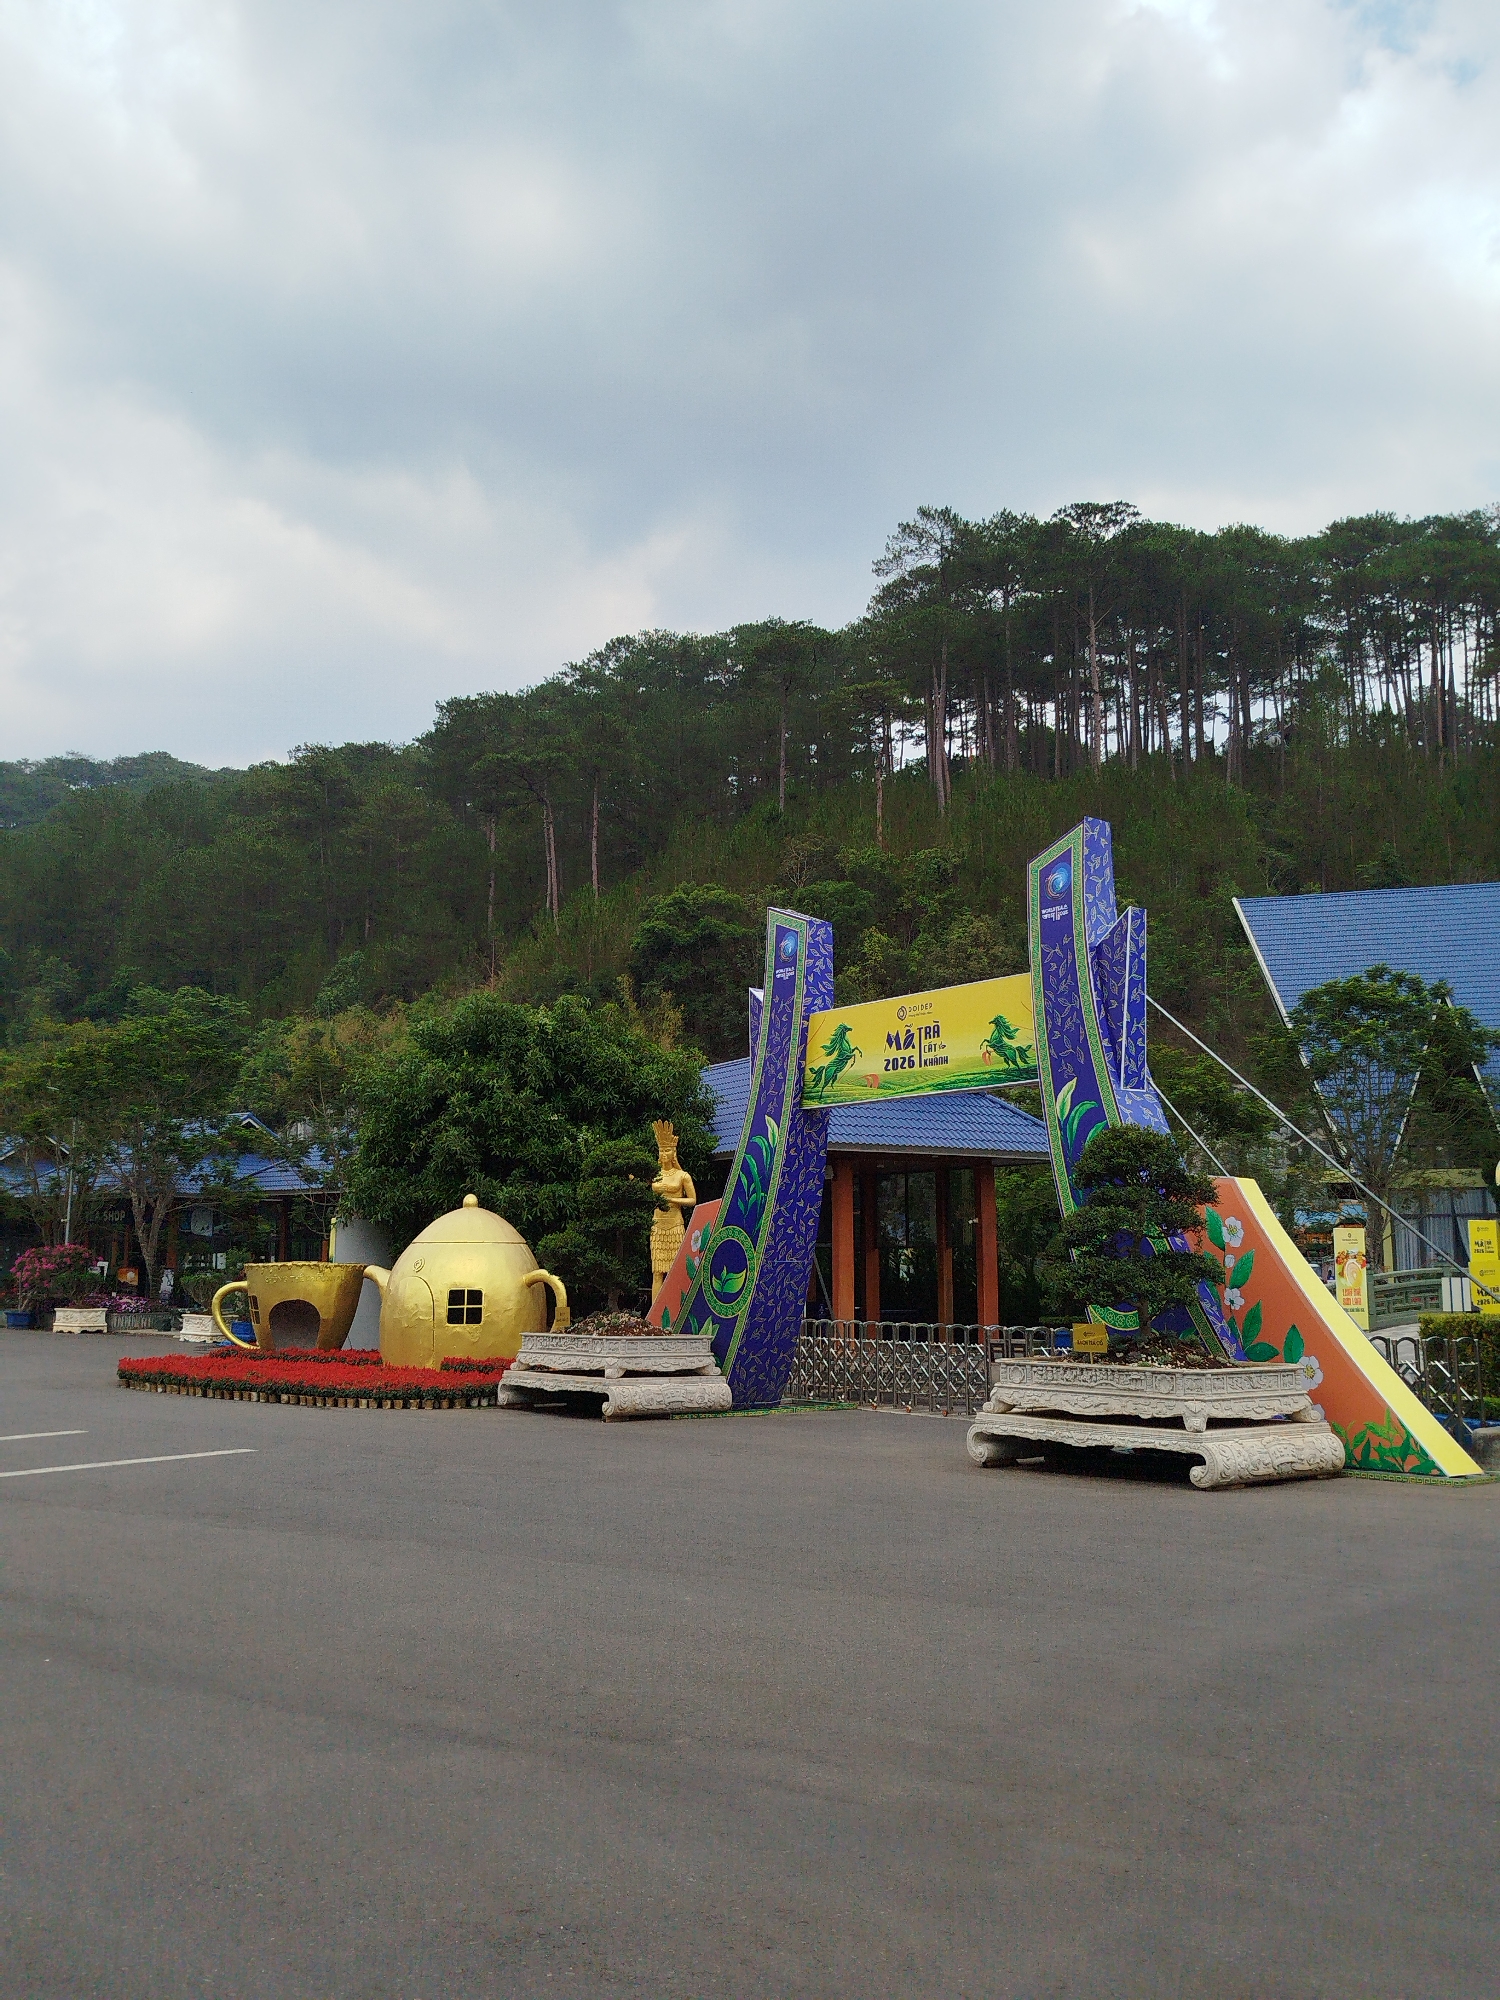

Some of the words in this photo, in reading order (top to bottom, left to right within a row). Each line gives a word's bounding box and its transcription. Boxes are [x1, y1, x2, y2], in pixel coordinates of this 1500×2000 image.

[923, 1041, 937, 1054] CÁT
[883, 1055, 916, 1072] 2026
[923, 1054, 948, 1067] KHÁNH
[103, 1210, 126, 1222] SHOP
